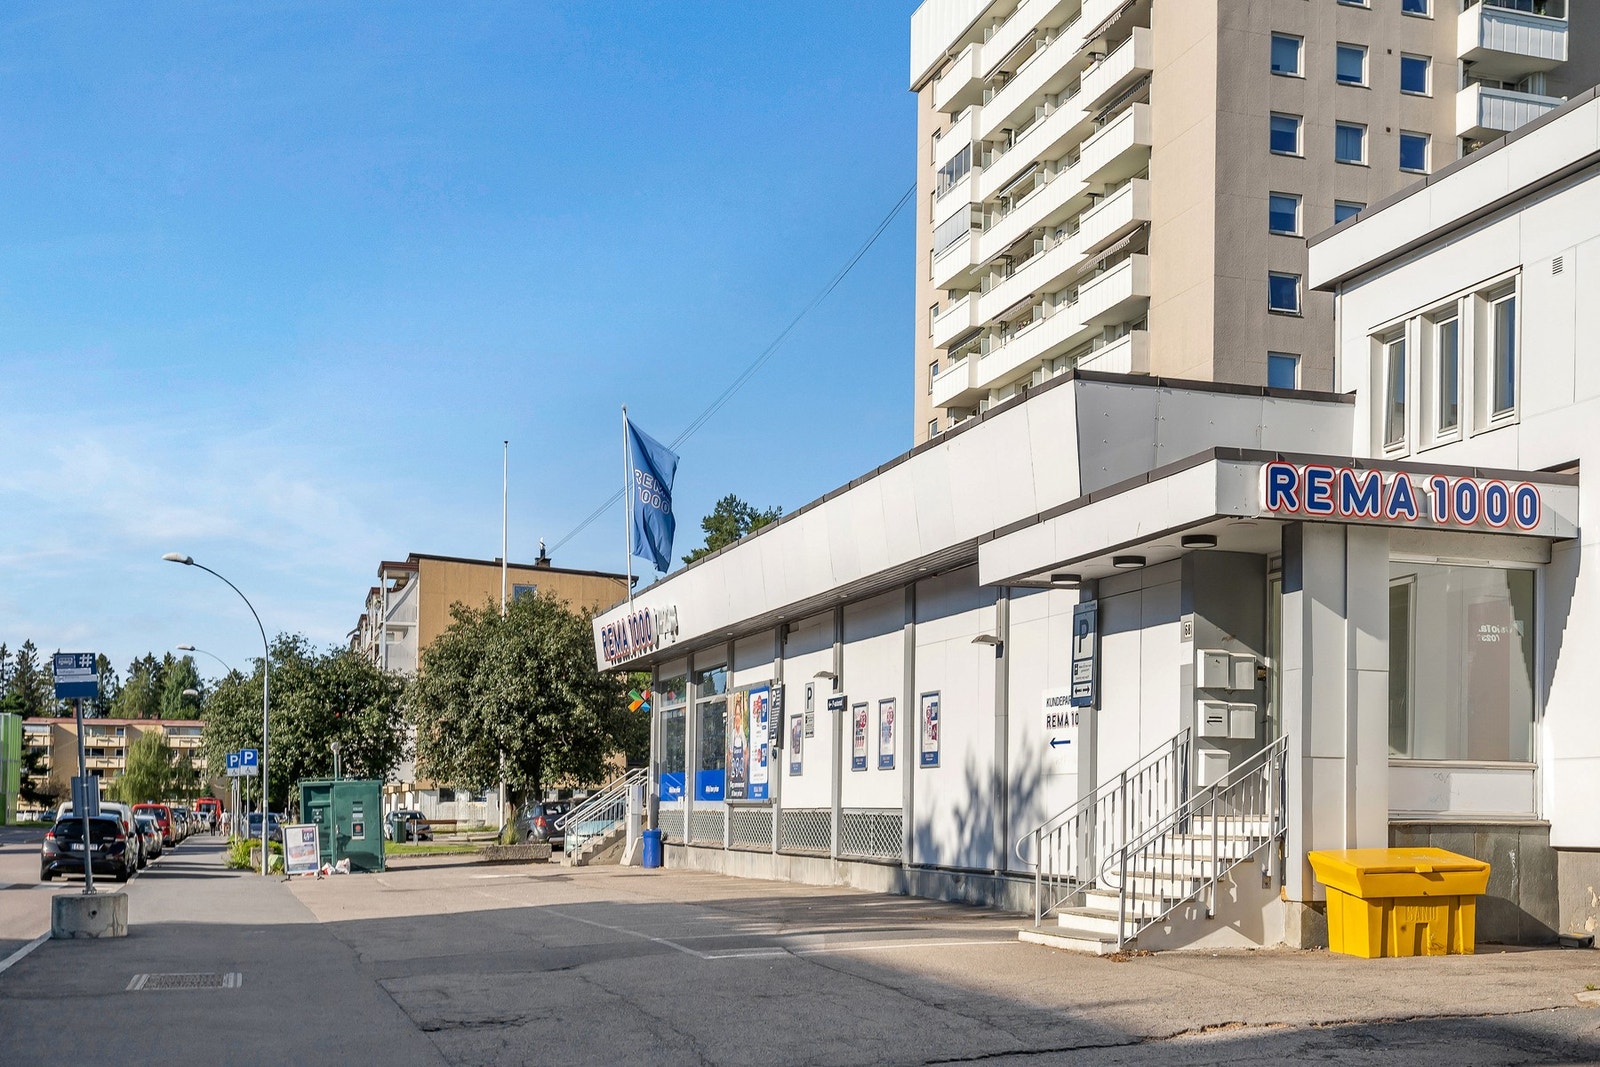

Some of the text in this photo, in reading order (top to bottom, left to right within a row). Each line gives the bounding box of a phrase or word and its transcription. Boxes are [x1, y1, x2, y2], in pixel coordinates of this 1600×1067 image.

[638, 486, 670, 514] 1000
[1265, 461, 1541, 531] REMA 1000
[601, 607, 655, 661] REMA 1000
[1078, 618, 1089, 653] P
[806, 687, 812, 709] P
[1046, 713, 1070, 728] REMA
[230, 755, 239, 767] P
[244, 751, 254, 765] P
